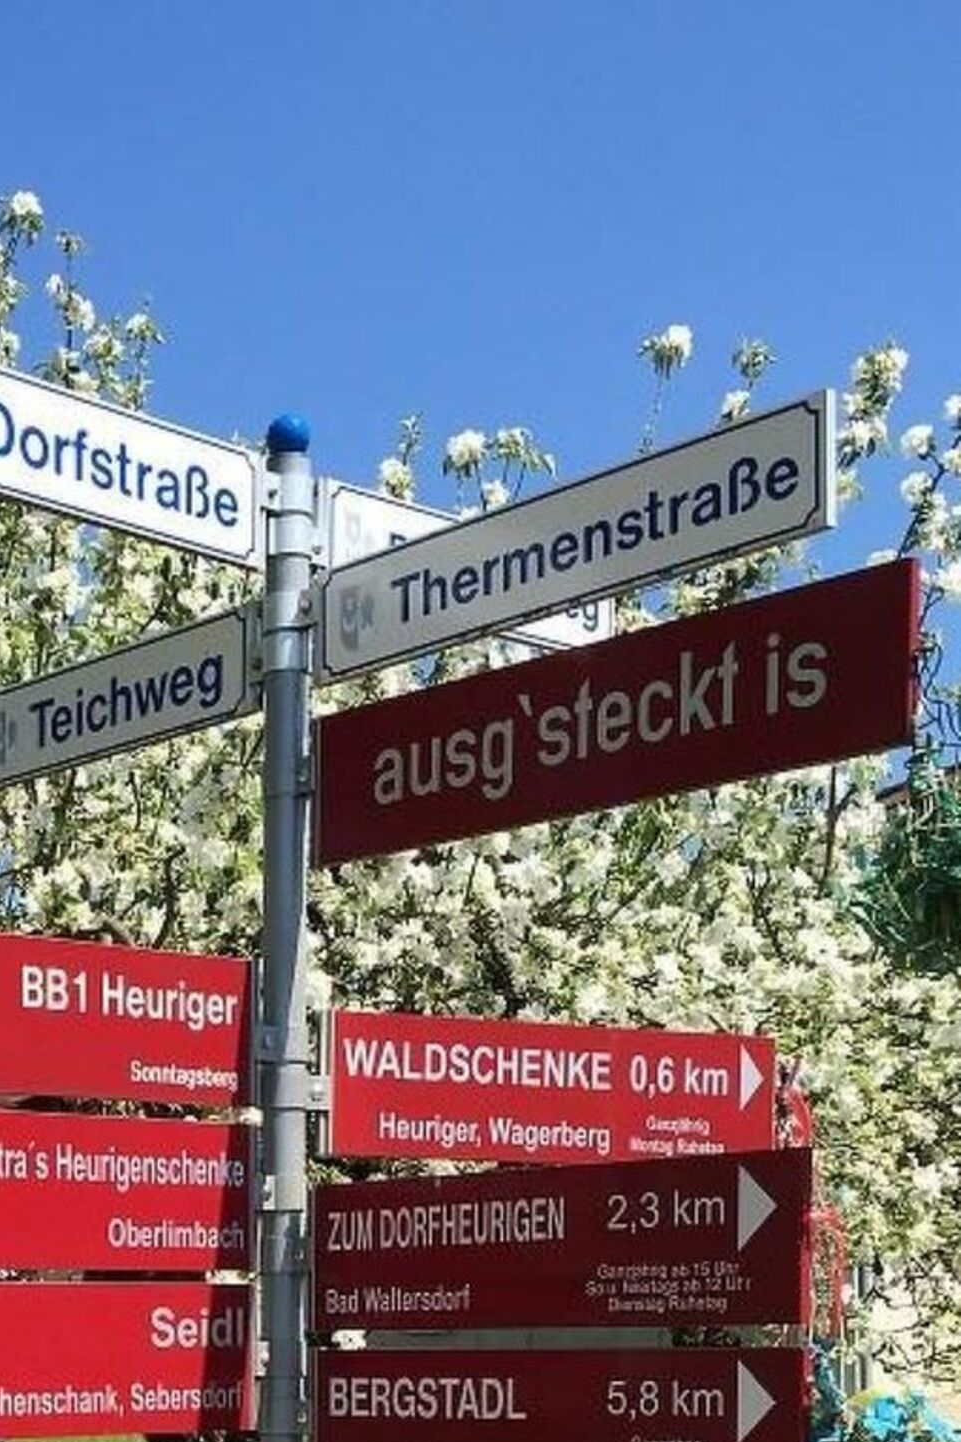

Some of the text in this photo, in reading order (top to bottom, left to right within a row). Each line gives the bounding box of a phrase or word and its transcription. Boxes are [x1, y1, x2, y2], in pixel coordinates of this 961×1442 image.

[391, 455, 799, 624] Thermenstraße
[766, 631, 829, 715] is
[29, 653, 223, 748] Teichweg
[21, 965, 238, 1030] BB1 Heuriger
[130, 1059, 238, 1092] Sonntagsberg
[343, 1037, 729, 1099] WALDSCHENKE 0,6 km
[379, 1111, 611, 1155] Heuriger, Wagerberg
[55, 1143, 245, 1192] Heurigenschenke
[107, 1218, 245, 1249] Oberlimbach
[326, 1196, 566, 1251] ZUM DORFHEURIGEN
[606, 1188, 726, 1234] 2,3 km
[324, 1287, 360, 1315] Bad
[150, 1305, 245, 1349] Seidl
[130, 1381, 242, 1413] Sebersdorf
[328, 1376, 528, 1420] BERGSTADL
[606, 1380, 725, 1421] 5,8 km
